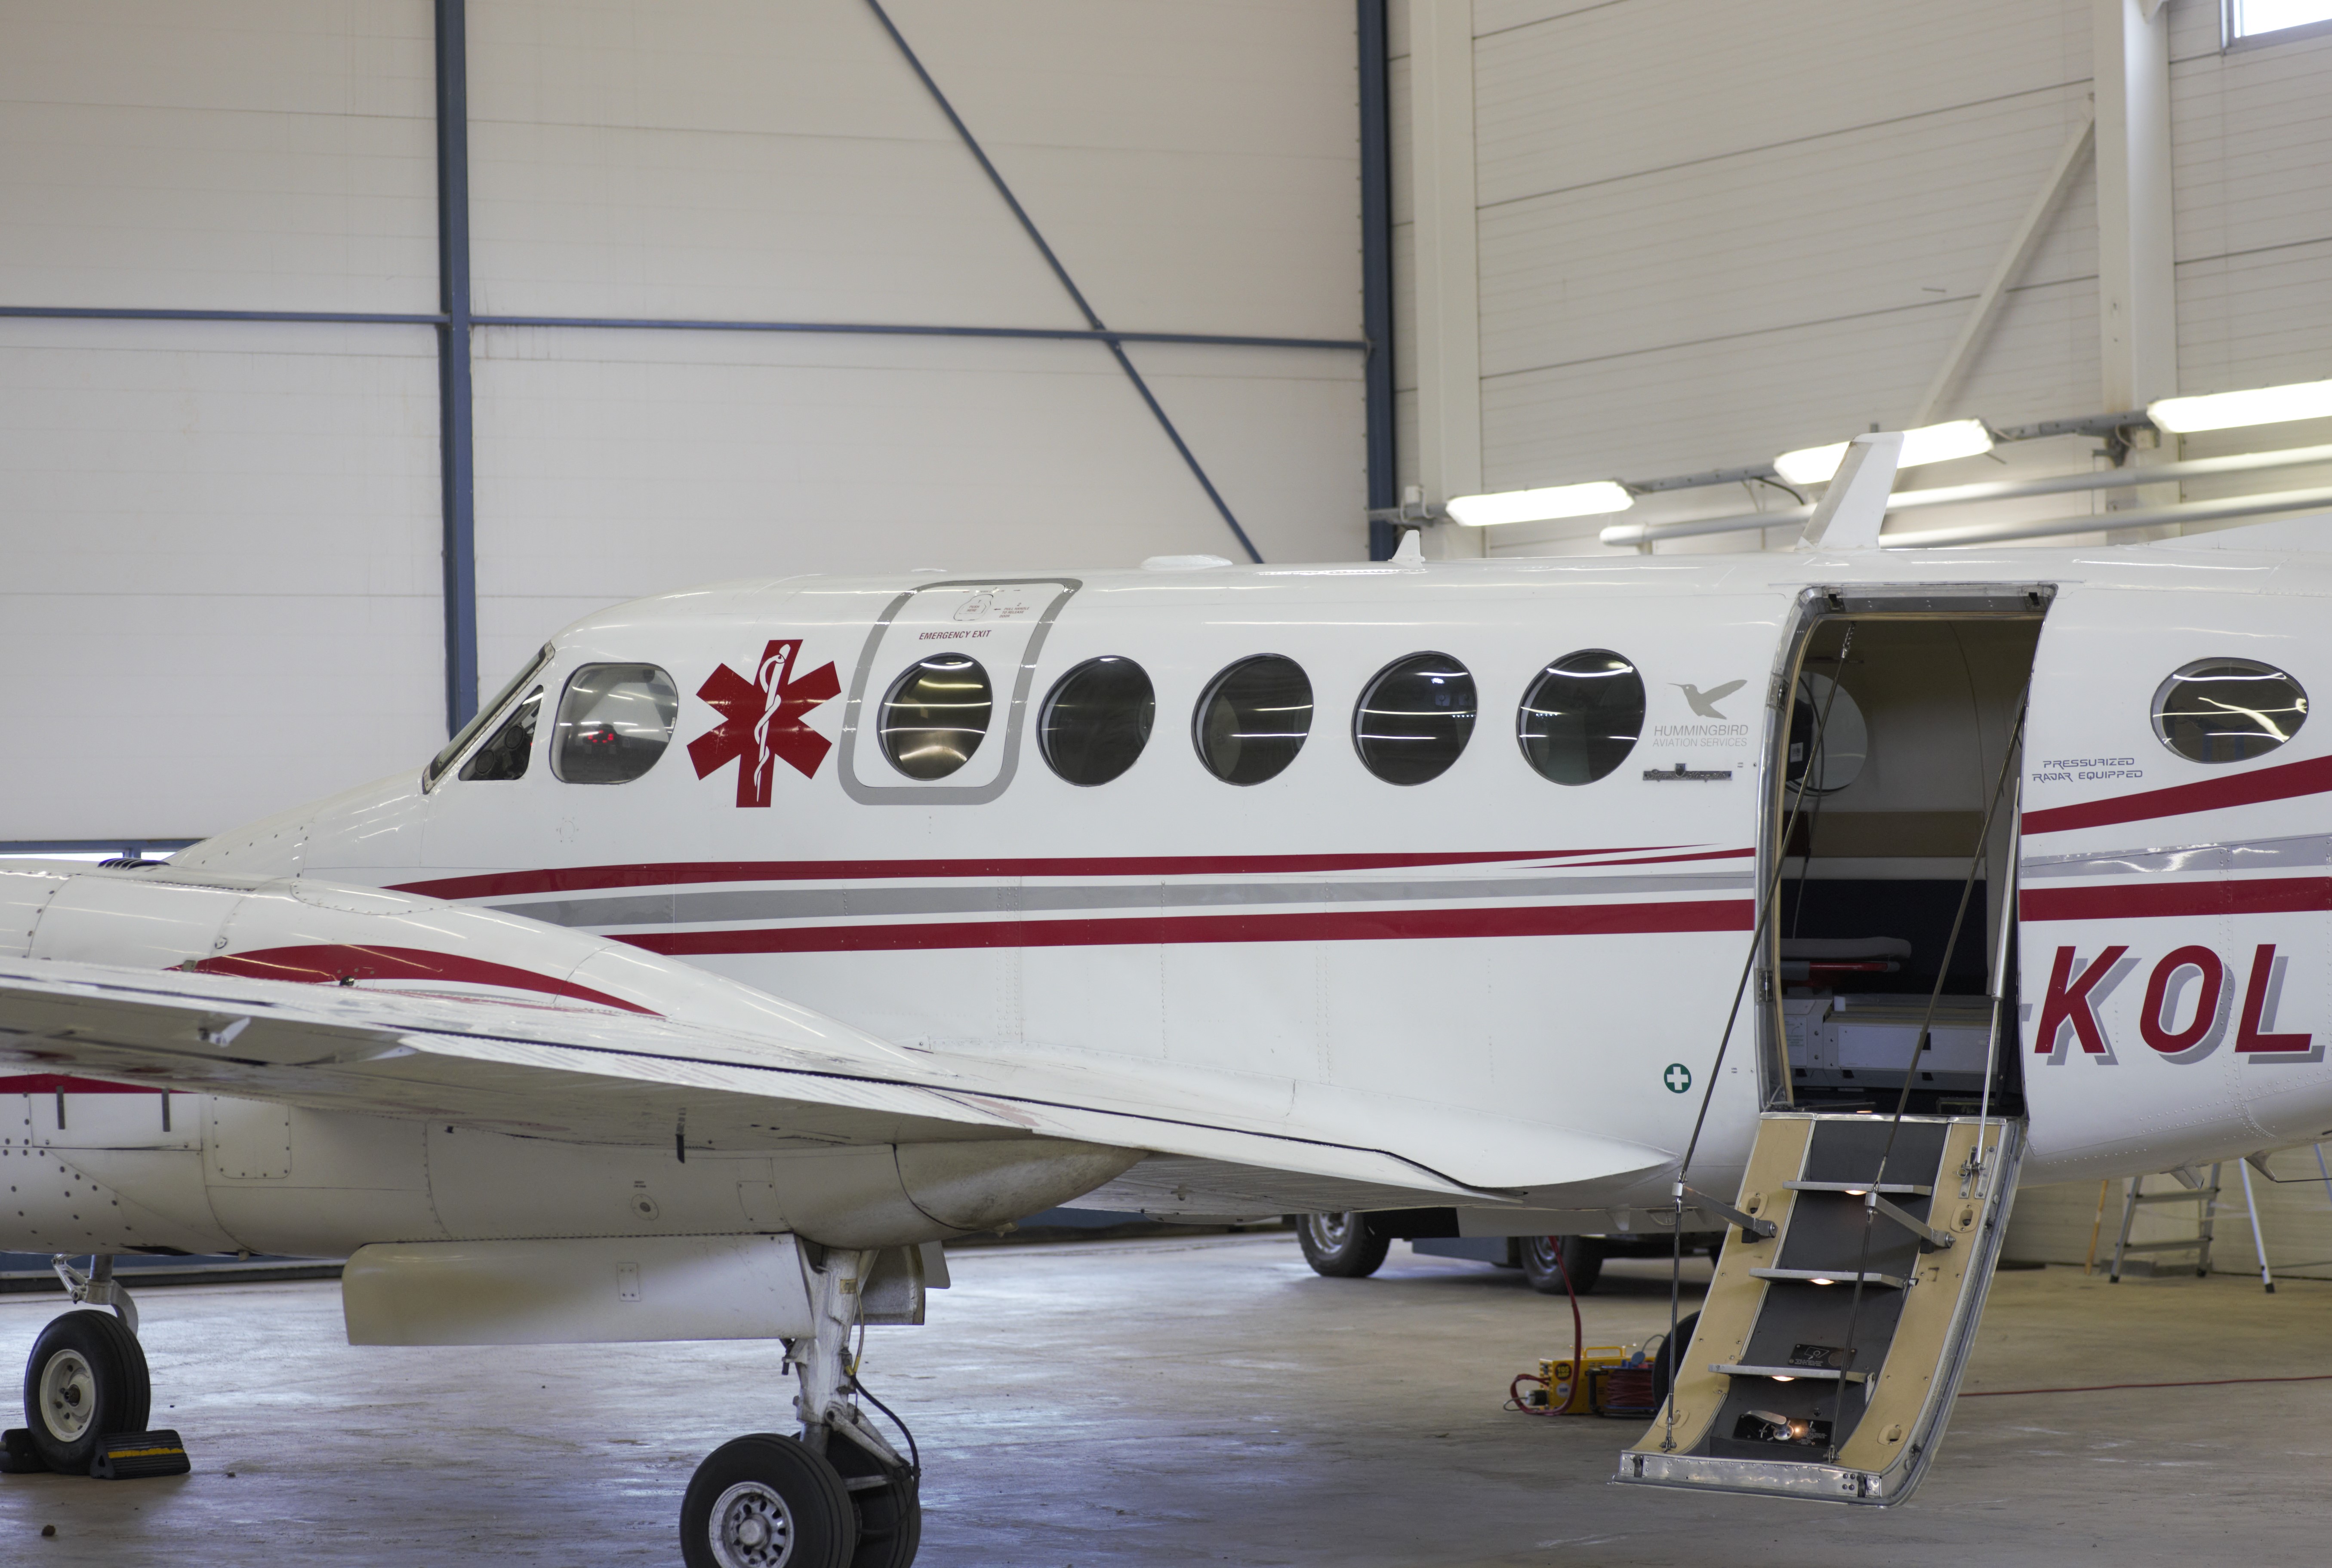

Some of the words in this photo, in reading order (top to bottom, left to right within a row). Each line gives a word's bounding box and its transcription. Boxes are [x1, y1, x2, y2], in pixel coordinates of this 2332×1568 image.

[919, 631, 971, 640] EMERGENCY
[1654, 725, 1749, 736] HUMMINGBIRD
[1652, 738, 1697, 747] AVIATION
[1700, 738, 1747, 747] SERVICES
[2043, 758, 2135, 769] PRESSURIZED
[2032, 772, 2073, 783] RADAR
[2078, 770, 2143, 780] EQUIPPED
